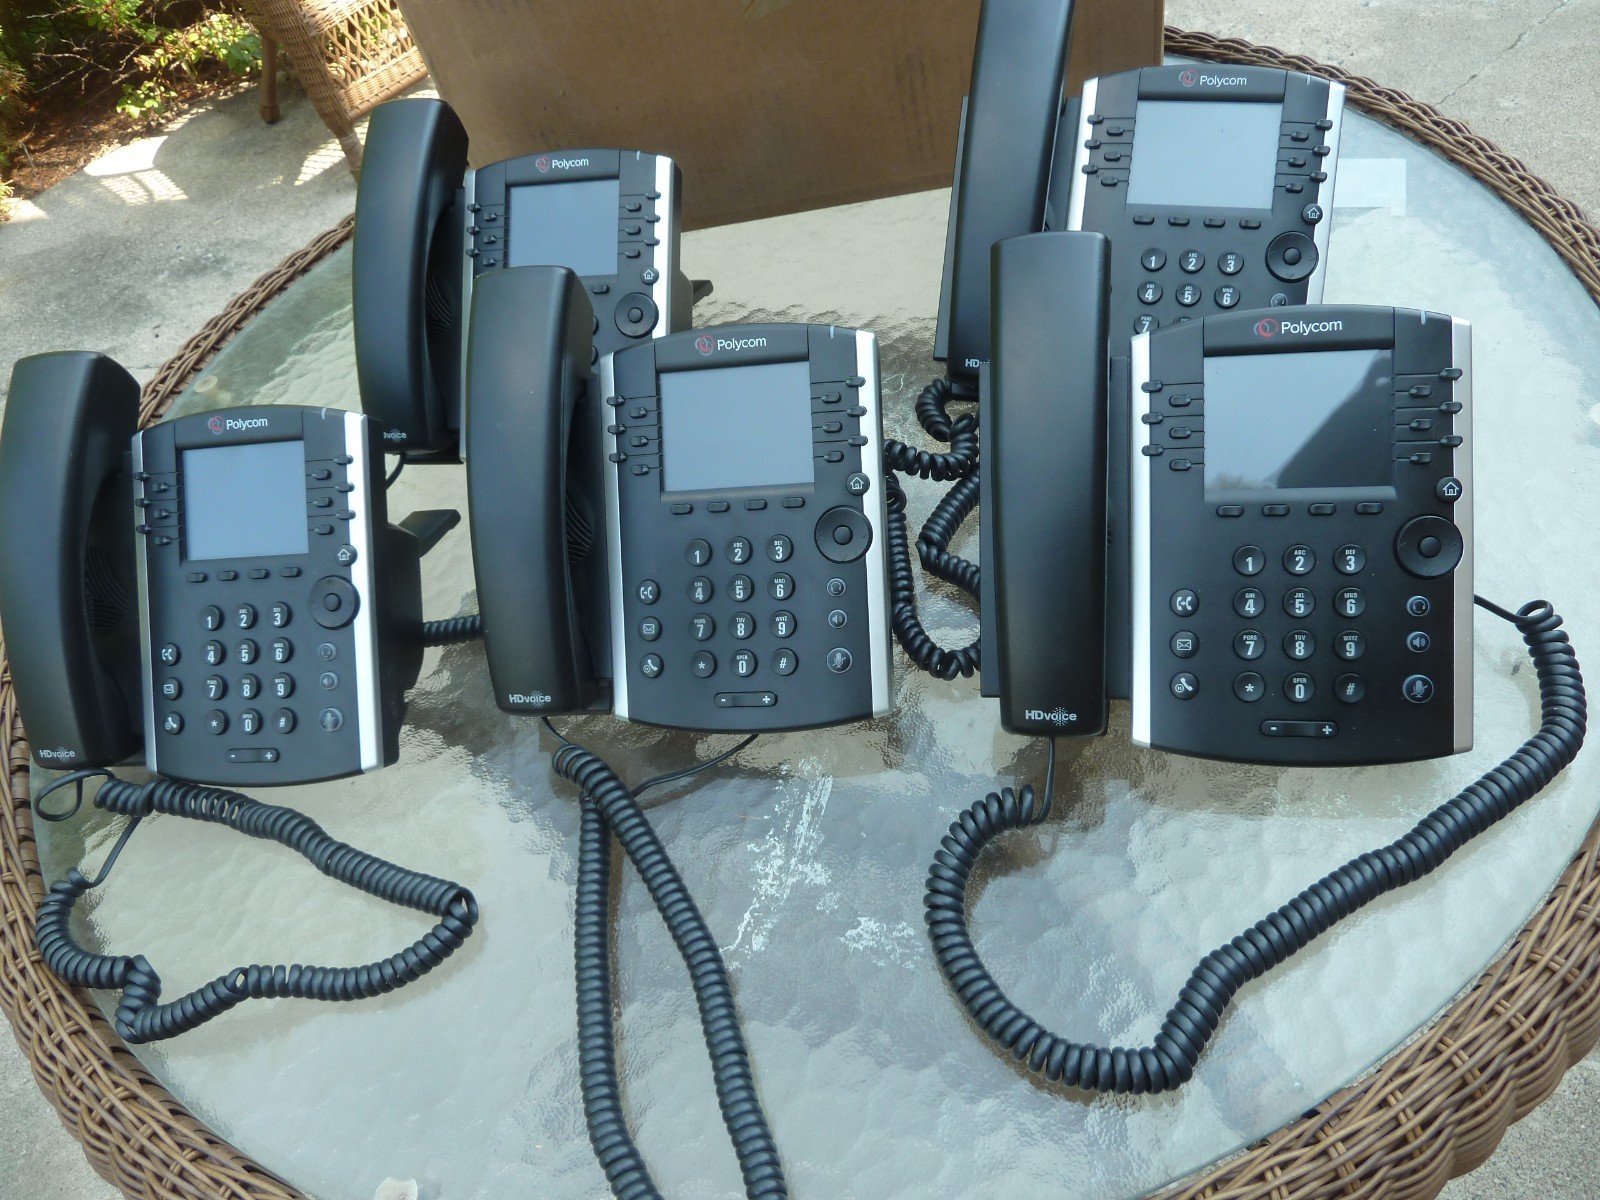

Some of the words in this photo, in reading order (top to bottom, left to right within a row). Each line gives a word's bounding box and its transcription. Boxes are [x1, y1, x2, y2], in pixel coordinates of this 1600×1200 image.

[1200, 75, 1247, 87] Polycom
[552, 159, 589, 169] Polycom
[1151, 256, 1155, 267] 1
[1188, 258, 1196, 269] 2
[1227, 260, 1234, 271] 3
[1145, 289, 1153, 300] 4
[1184, 291, 1191, 303] 5
[1223, 293, 1230, 305] 6
[1142, 321, 1149, 332] 7
[1281, 321, 1342, 335] Polycom
[717, 338, 766, 351] Polycom
[226, 418, 268, 430] Polycom
[695, 550, 699, 563] 1
[735, 548, 741, 561] 2
[776, 546, 782, 559] 3
[1246, 557, 1252, 571] 1
[1295, 556, 1304, 571] 2
[1346, 556, 1355, 571] 3
[695, 587, 703, 600] 4
[736, 586, 743, 599] 5
[777, 584, 783, 597] 6
[1245, 599, 1255, 613] 4
[1296, 599, 1304, 613] 5
[1347, 599, 1355, 614] 6
[207, 616, 211, 628] 1
[240, 614, 246, 626] 2
[274, 613, 281, 625] 3
[697, 624, 703, 637] 7
[737, 623, 744, 636] 8
[778, 622, 785, 635] 9
[276, 648, 282, 660] 6
[1246, 641, 1254, 655] 7
[1296, 641, 1304, 656] 8
[1346, 642, 1355, 656] 9
[208, 650, 214, 663] 4
[242, 650, 248, 661] 5
[739, 661, 746, 673] 0
[780, 658, 786, 668] #
[209, 685, 215, 697] 7
[243, 684, 250, 696] 8
[277, 684, 284, 696] 9
[1296, 684, 1304, 698] 0
[1346, 683, 1355, 695] #
[1025, 709, 1077, 721] HDvoice
[245, 719, 251, 731] 0
[279, 717, 285, 727] #
